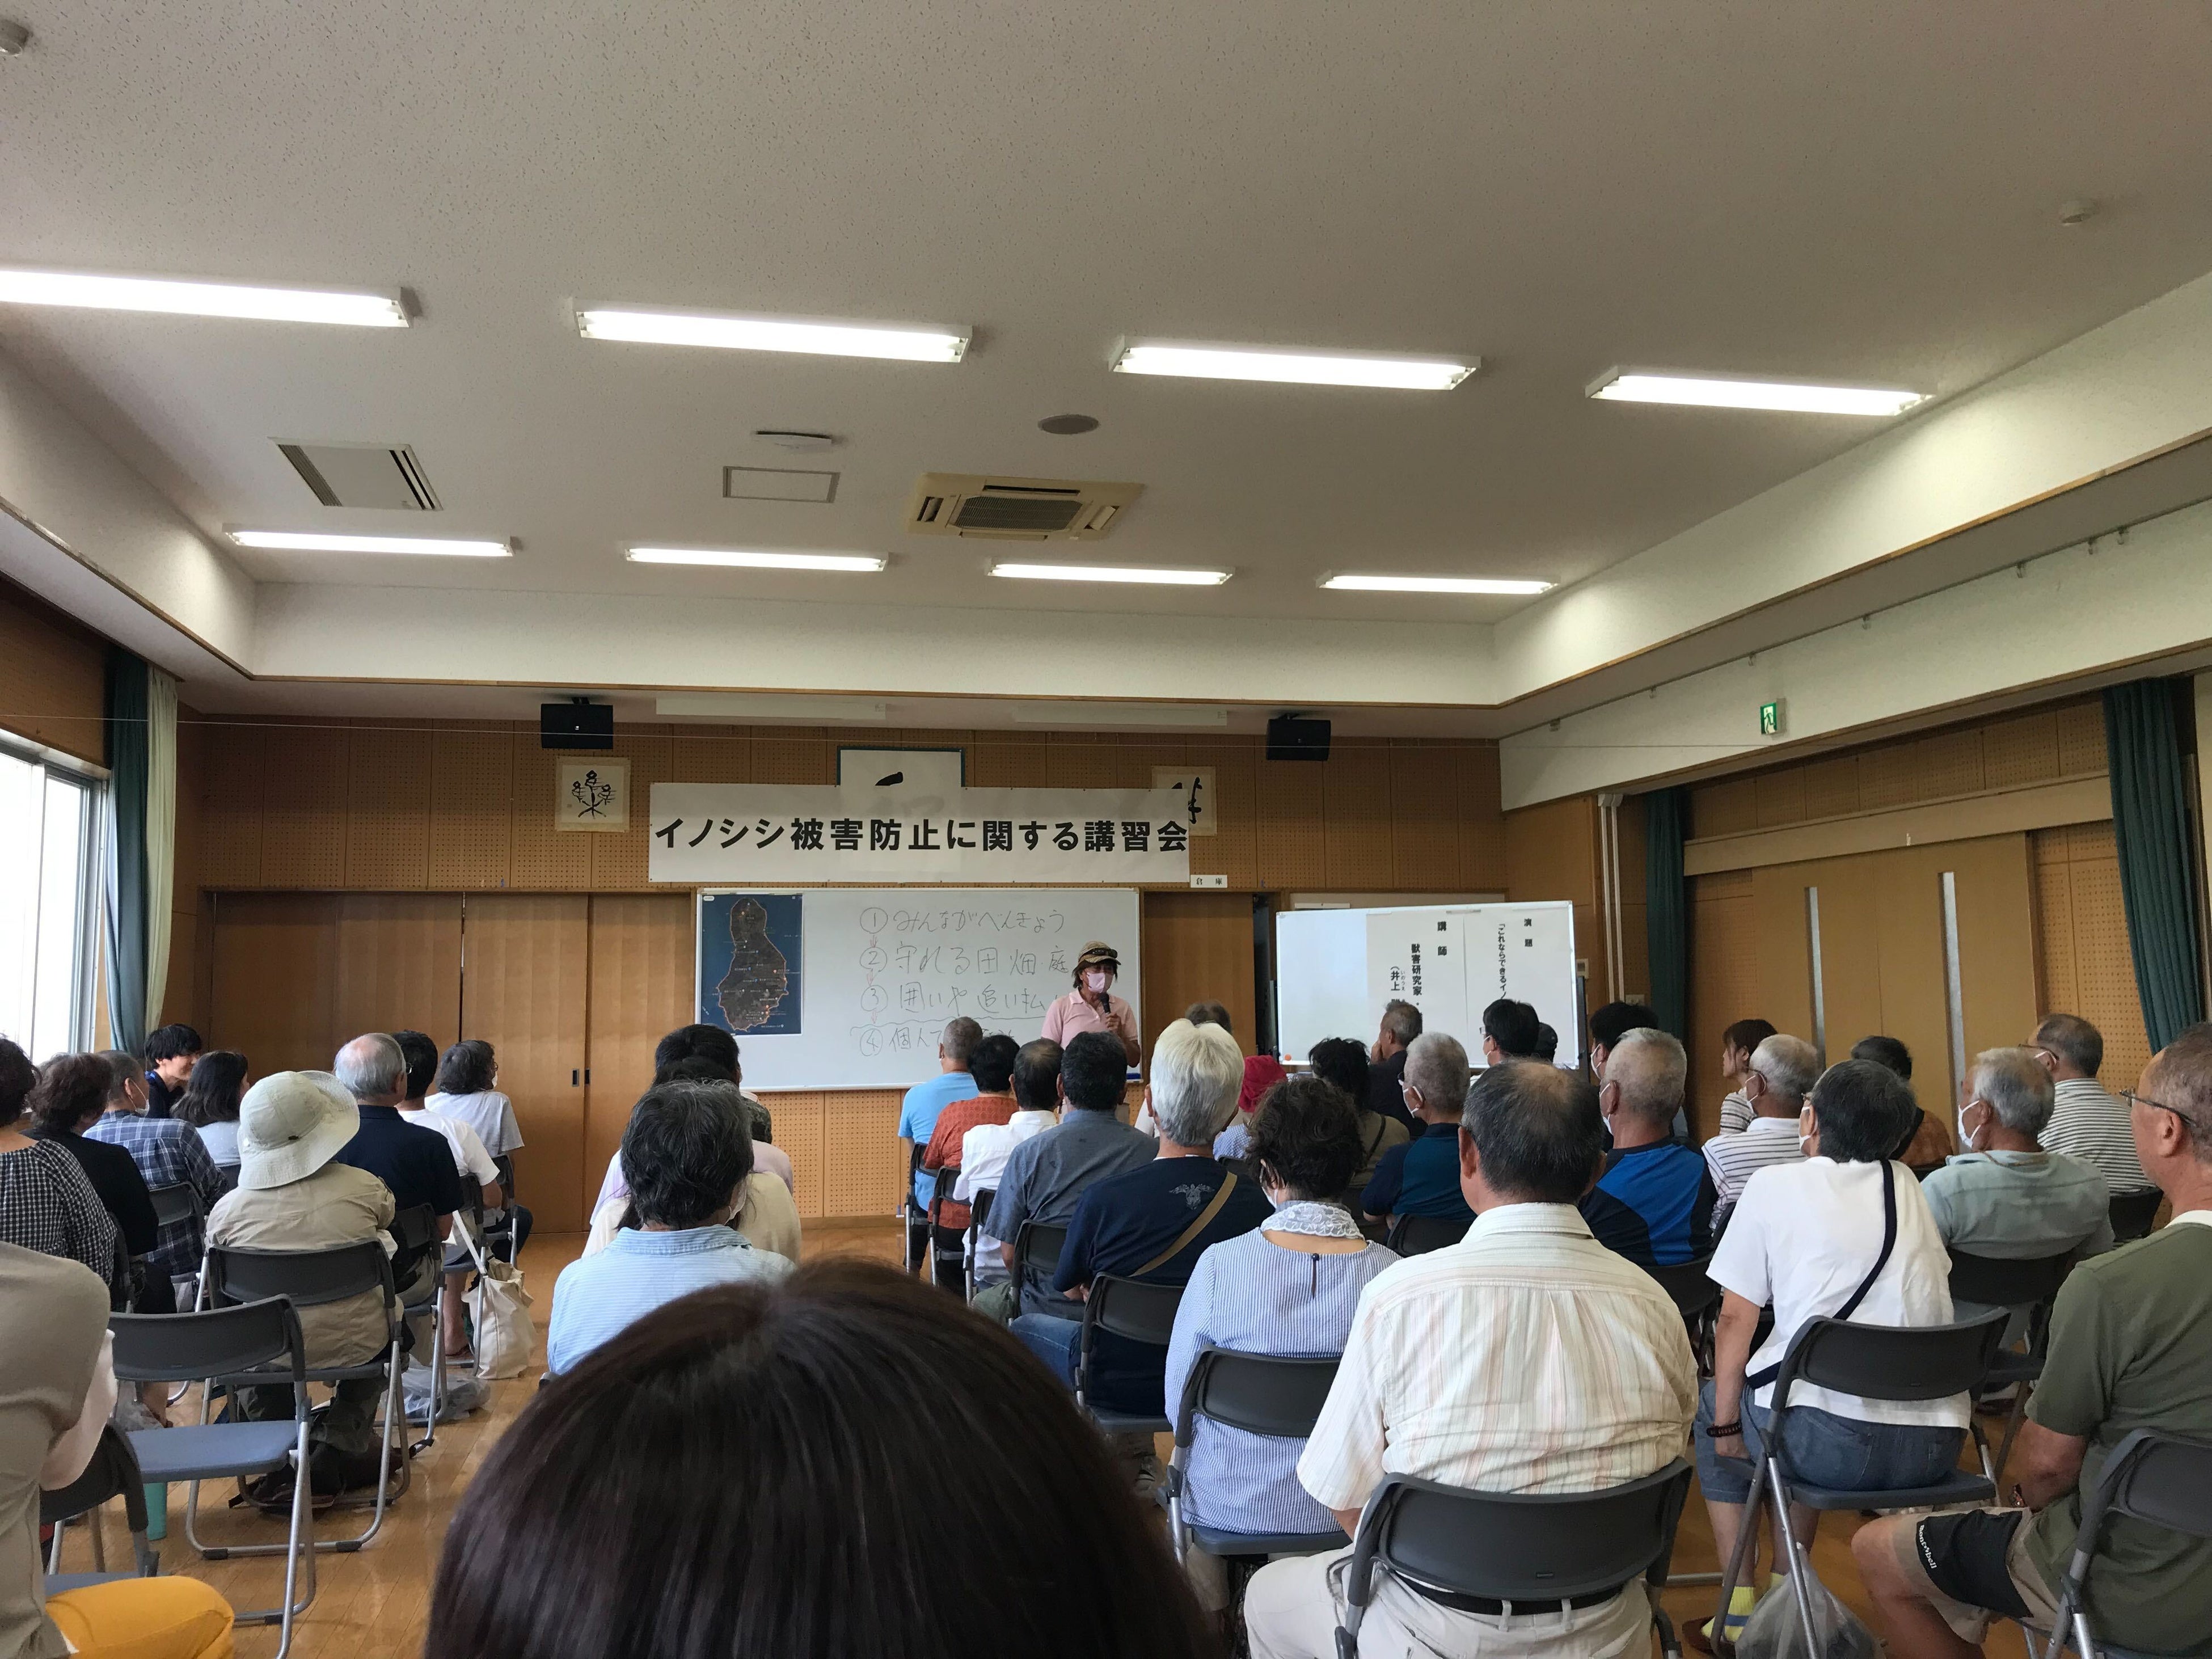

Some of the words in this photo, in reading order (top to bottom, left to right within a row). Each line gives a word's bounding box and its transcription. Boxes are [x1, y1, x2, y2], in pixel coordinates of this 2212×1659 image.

[655, 818, 1188, 852] イノシシ被害防止に関する講習会
